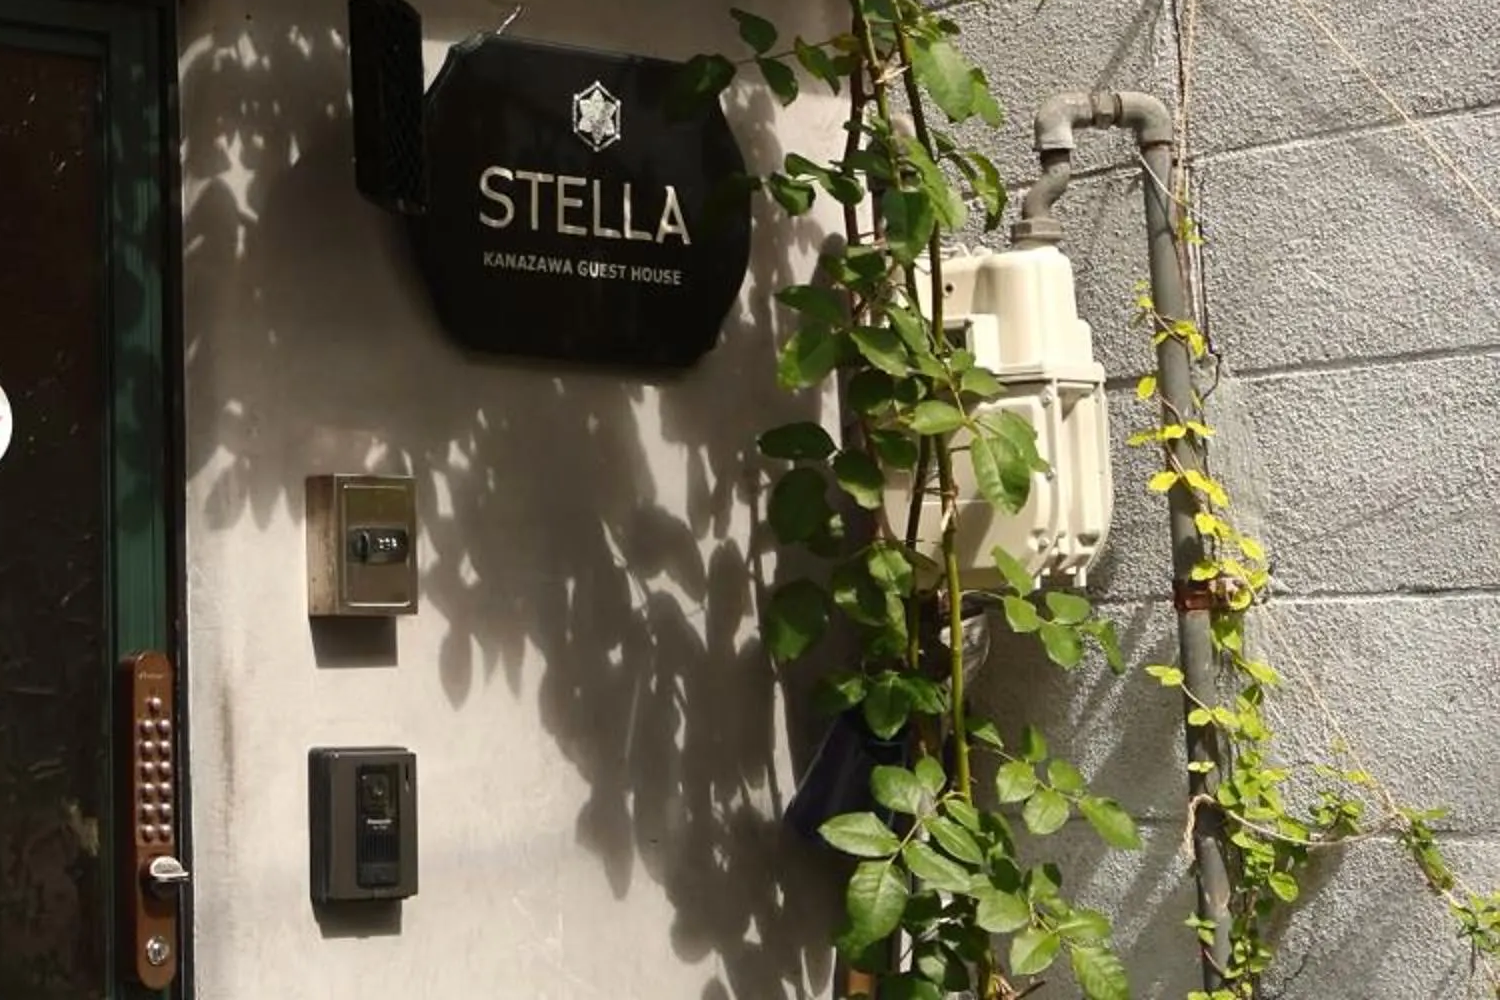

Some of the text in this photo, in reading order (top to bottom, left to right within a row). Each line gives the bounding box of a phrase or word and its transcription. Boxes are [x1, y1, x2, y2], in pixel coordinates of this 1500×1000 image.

[479, 165, 692, 245] STELLA
[483, 251, 682, 286] KANAZAWA GUEST HOUSE
